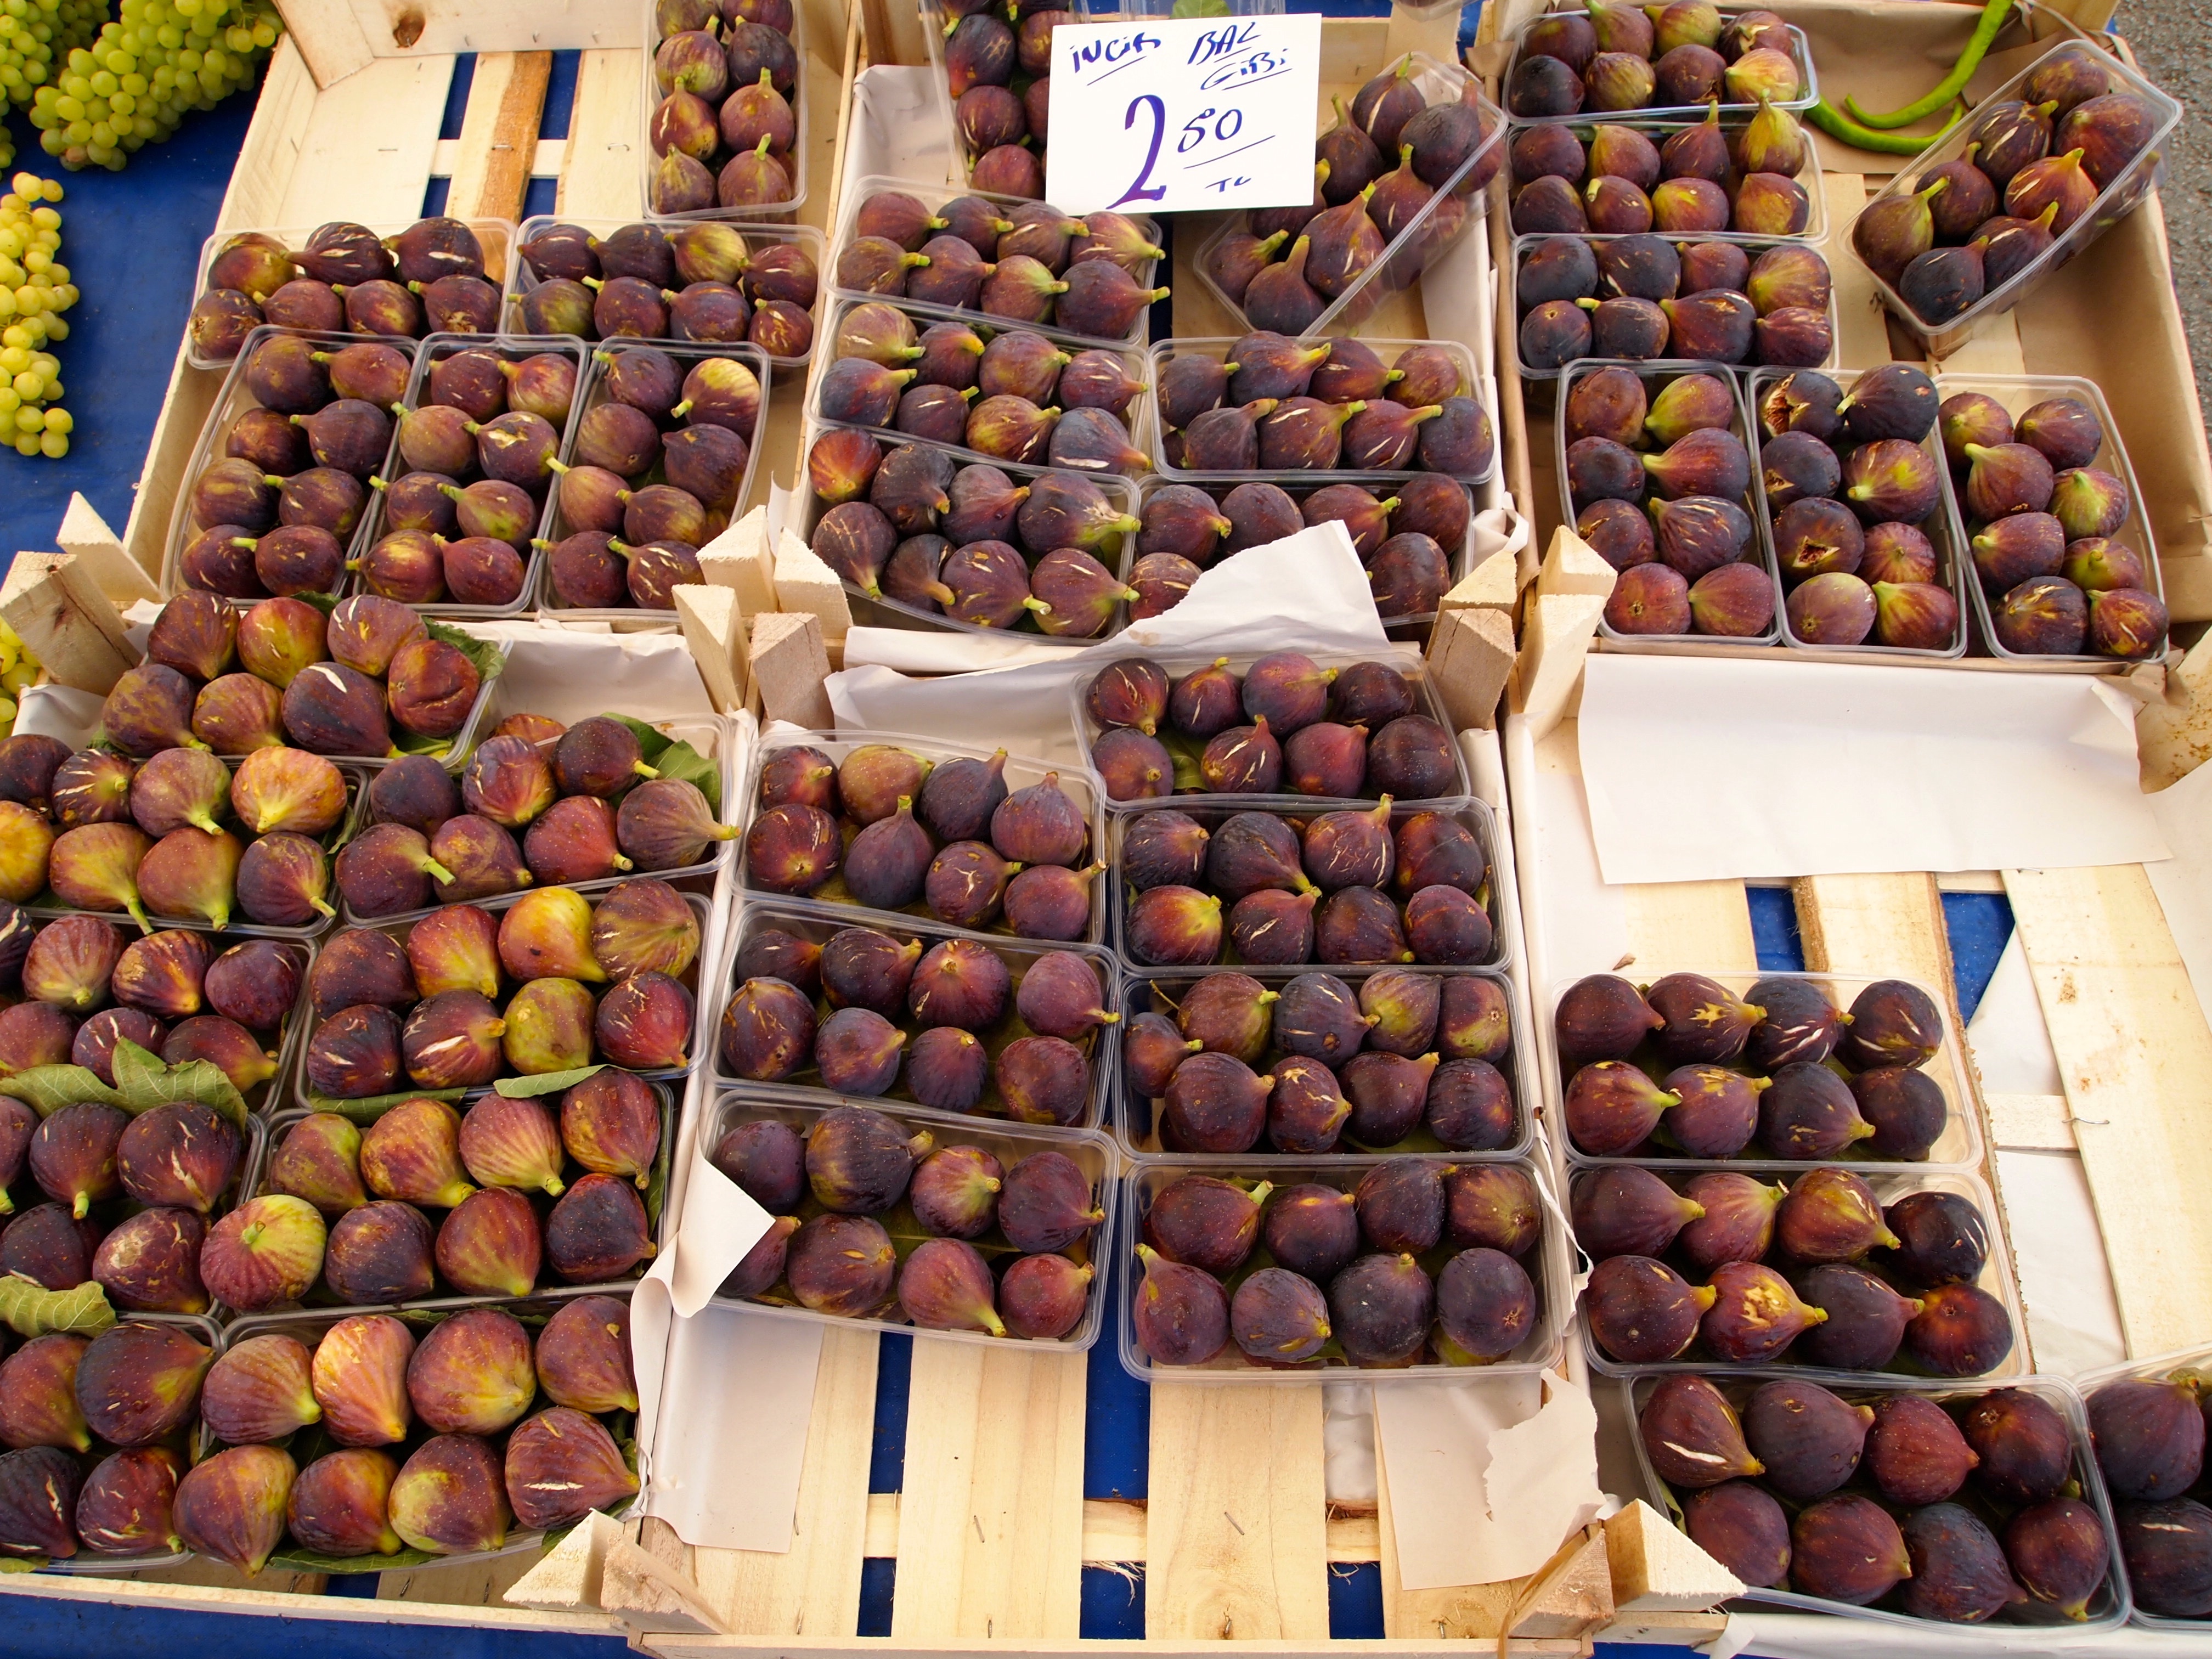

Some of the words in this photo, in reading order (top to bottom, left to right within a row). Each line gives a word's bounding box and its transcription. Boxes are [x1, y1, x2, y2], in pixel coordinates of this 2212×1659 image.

[1187, 21, 1262, 65] BAL
[1105, 94, 1167, 210] 2
[1177, 107, 1243, 154] 50
